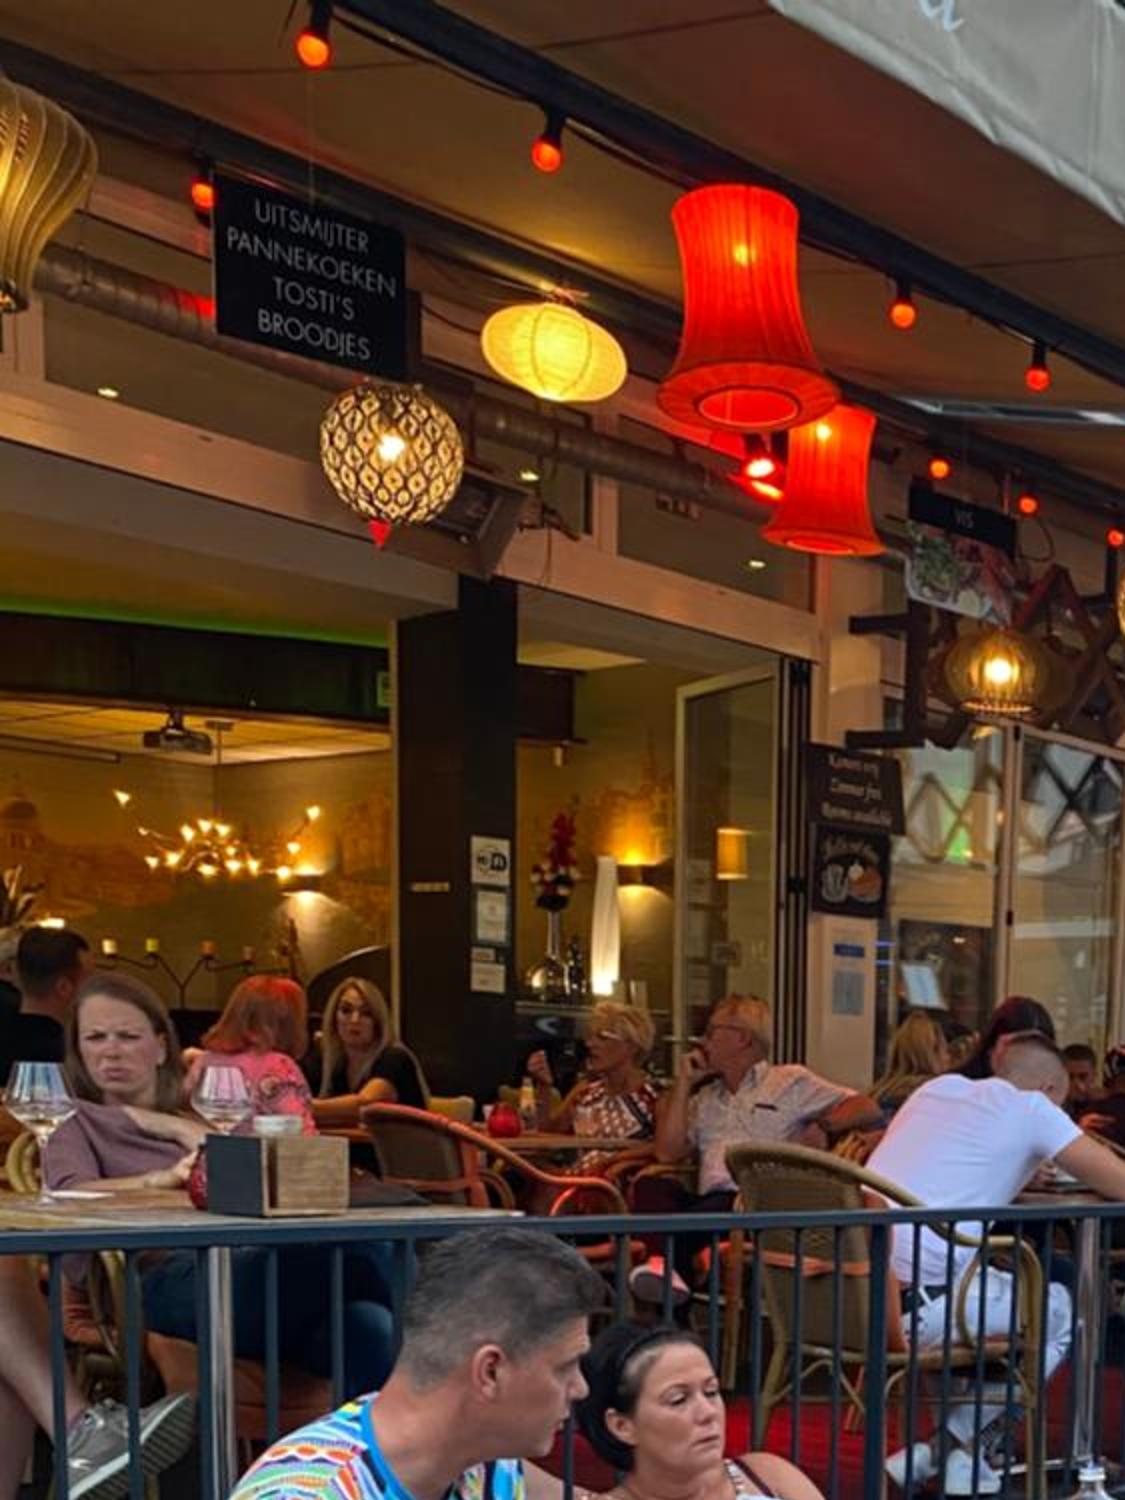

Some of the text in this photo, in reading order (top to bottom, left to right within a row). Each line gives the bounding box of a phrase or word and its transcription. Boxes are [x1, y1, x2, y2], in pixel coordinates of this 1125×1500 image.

[255, 198, 369, 254] UITSMIJTER
[226, 225, 397, 298] PANNEKOEKEN
[273, 275, 355, 320] TOSTI'S
[257, 308, 371, 360] BROODJES
